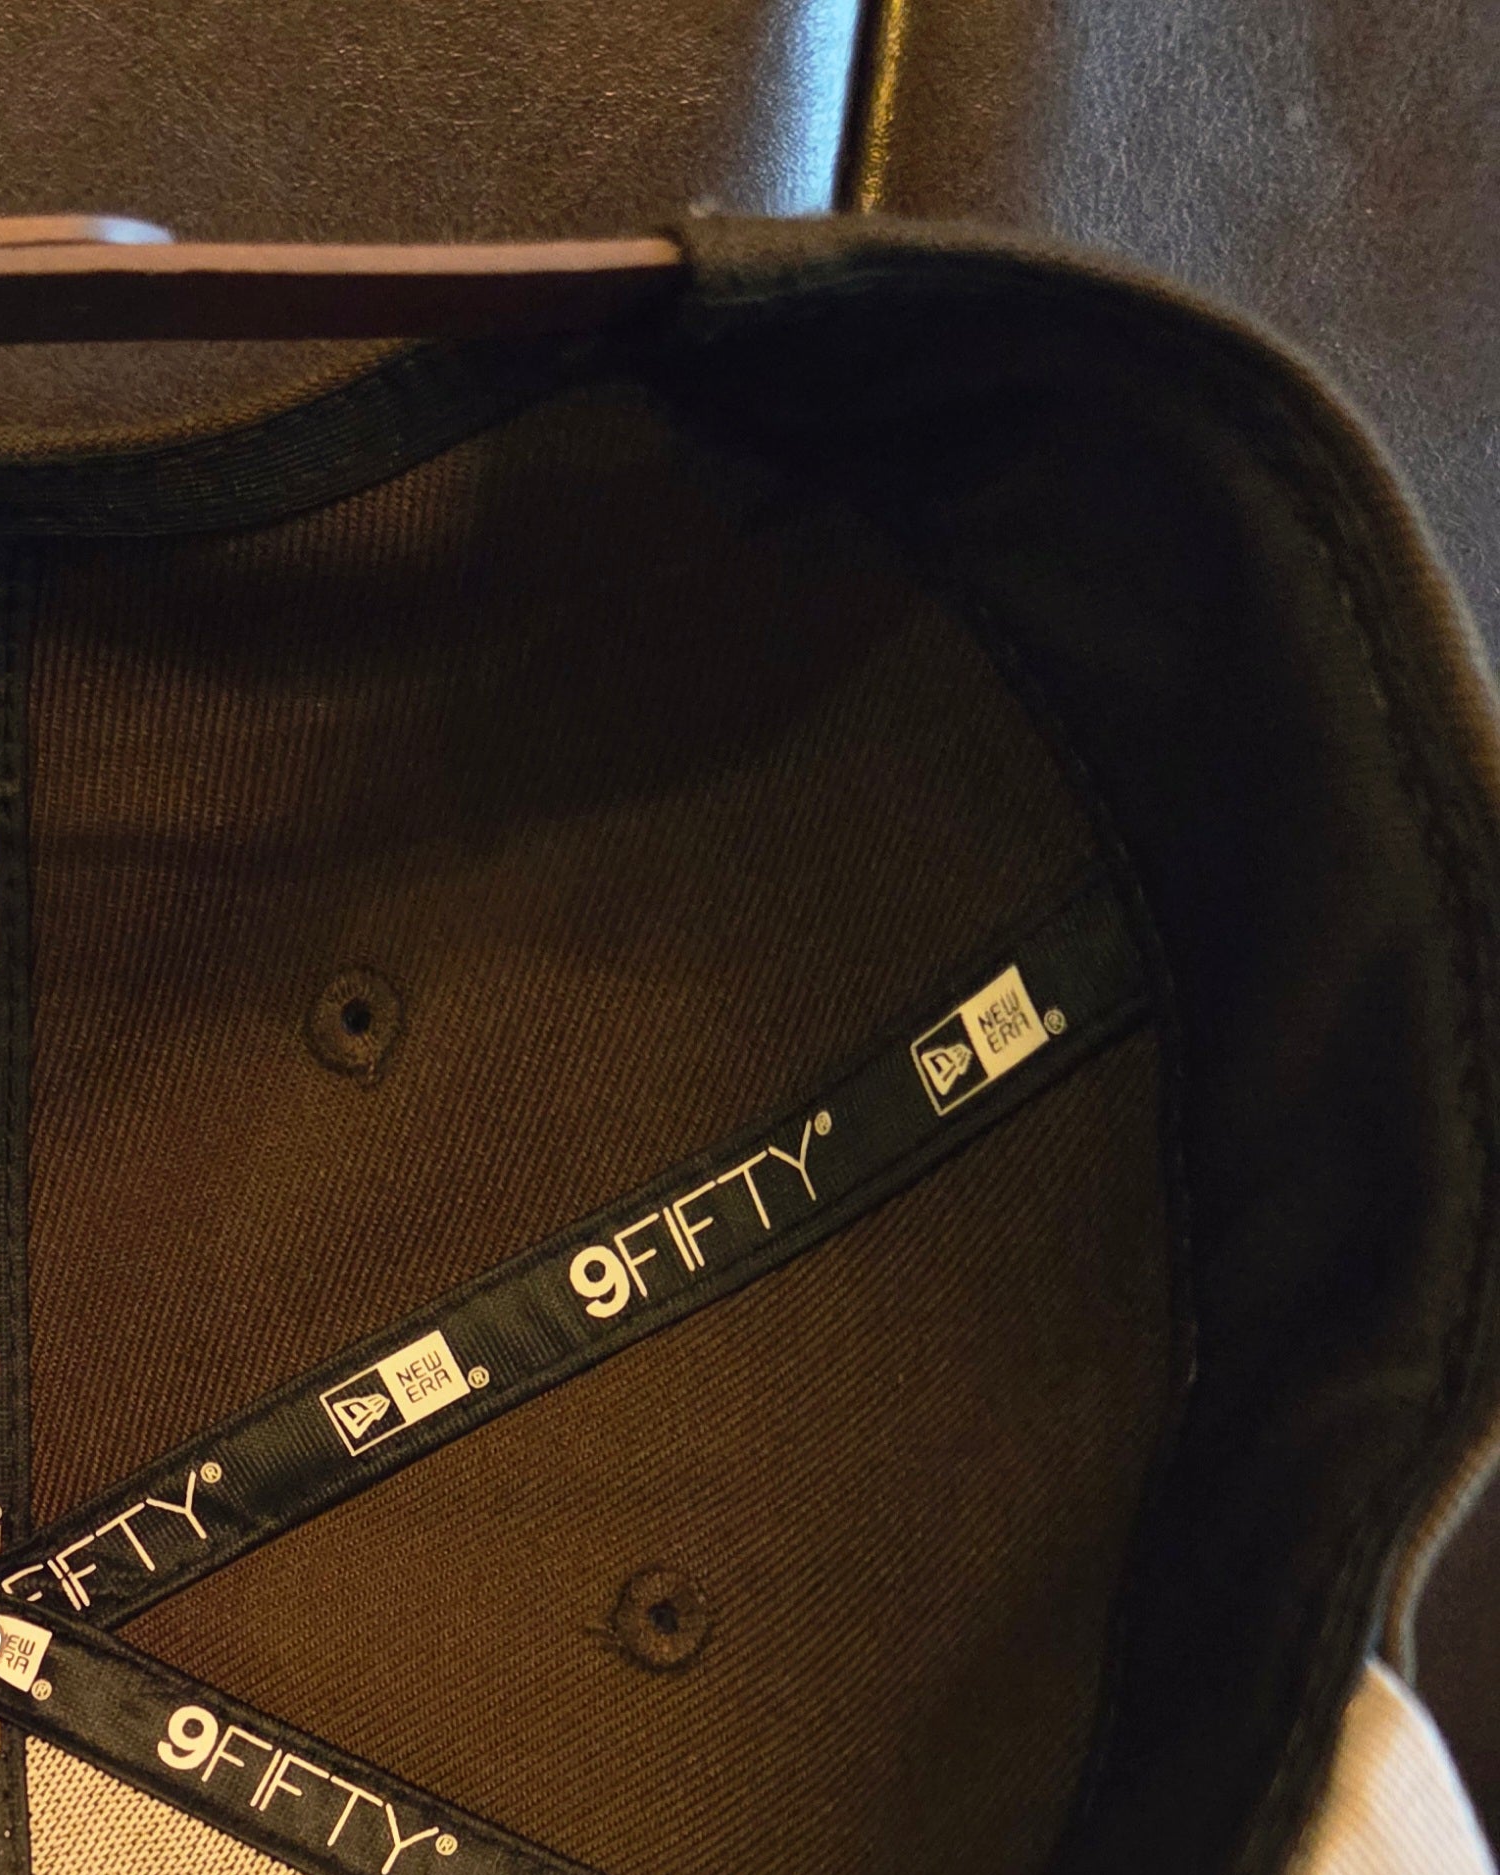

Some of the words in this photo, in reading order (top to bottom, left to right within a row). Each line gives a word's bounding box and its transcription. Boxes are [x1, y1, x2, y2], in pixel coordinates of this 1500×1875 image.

[978, 988, 1021, 1036] NEW
[986, 1011, 1032, 1054] ERA
[396, 1350, 442, 1387] NEW
[406, 1368, 452, 1403] ERA
